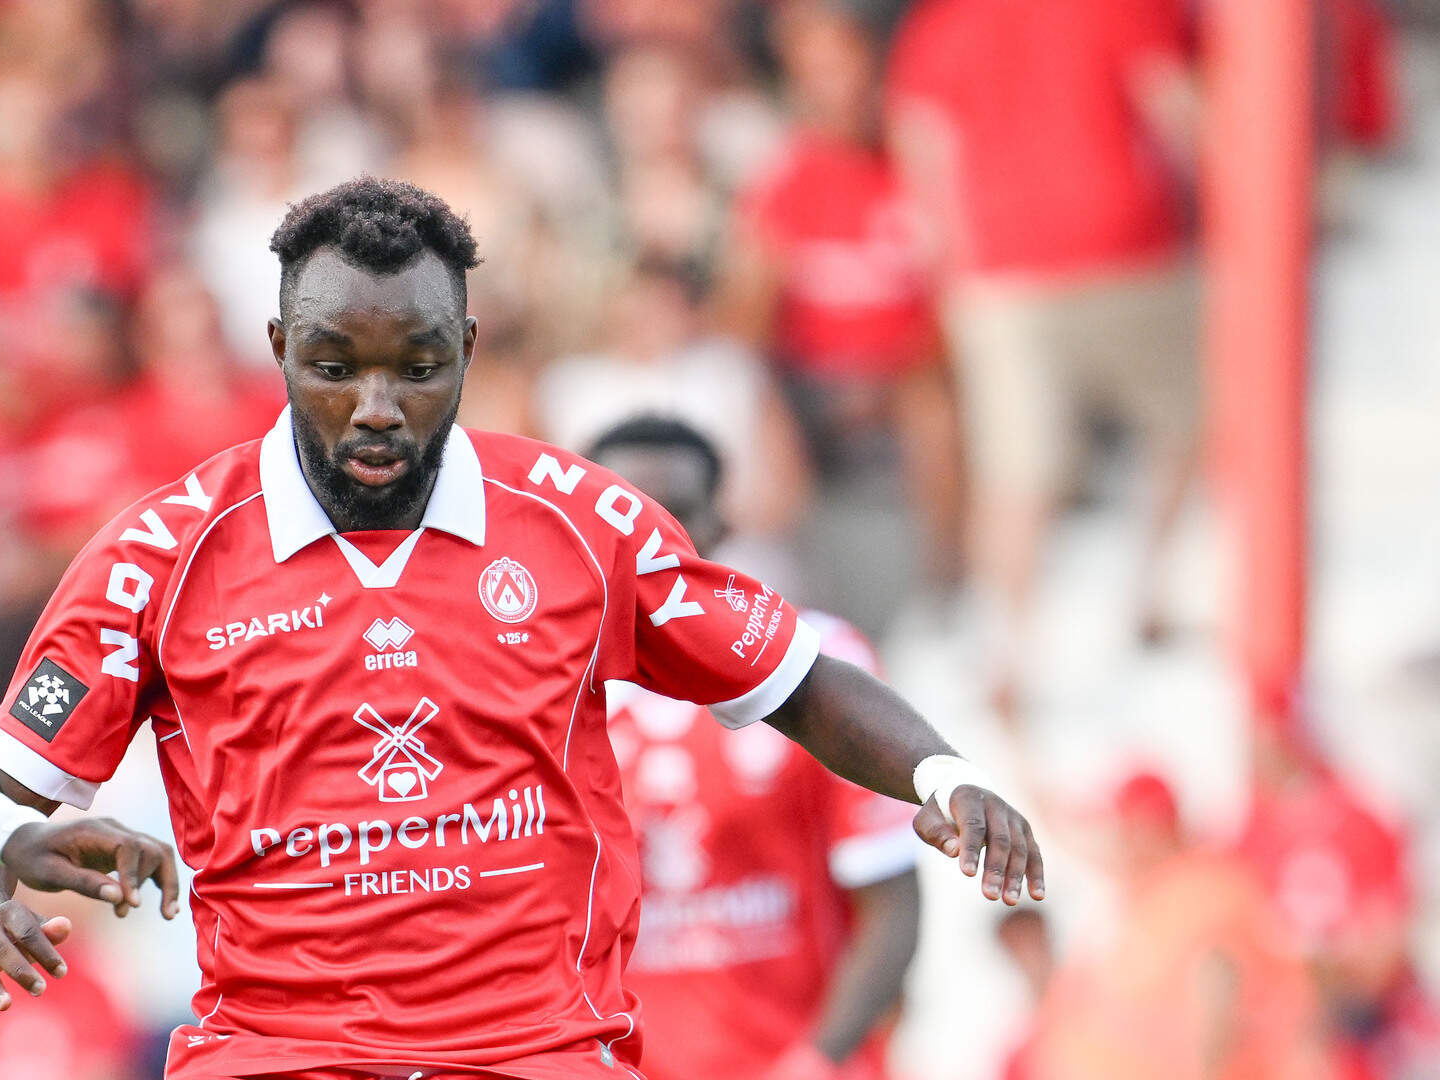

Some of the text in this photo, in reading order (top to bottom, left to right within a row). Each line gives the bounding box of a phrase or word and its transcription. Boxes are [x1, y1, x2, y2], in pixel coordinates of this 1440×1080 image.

[527, 452, 706, 628] NOVY
[100, 472, 214, 682] NOVY
[205, 605, 324, 651] SPARKI
[731, 583, 775, 659] PepperM
[764, 609, 783, 641] FRIENDS
[364, 650, 419, 672] errea
[18, 700, 54, 728] PRO LEAGUE
[250, 784, 546, 868] PepperMill
[343, 865, 472, 897] FRIENDS
